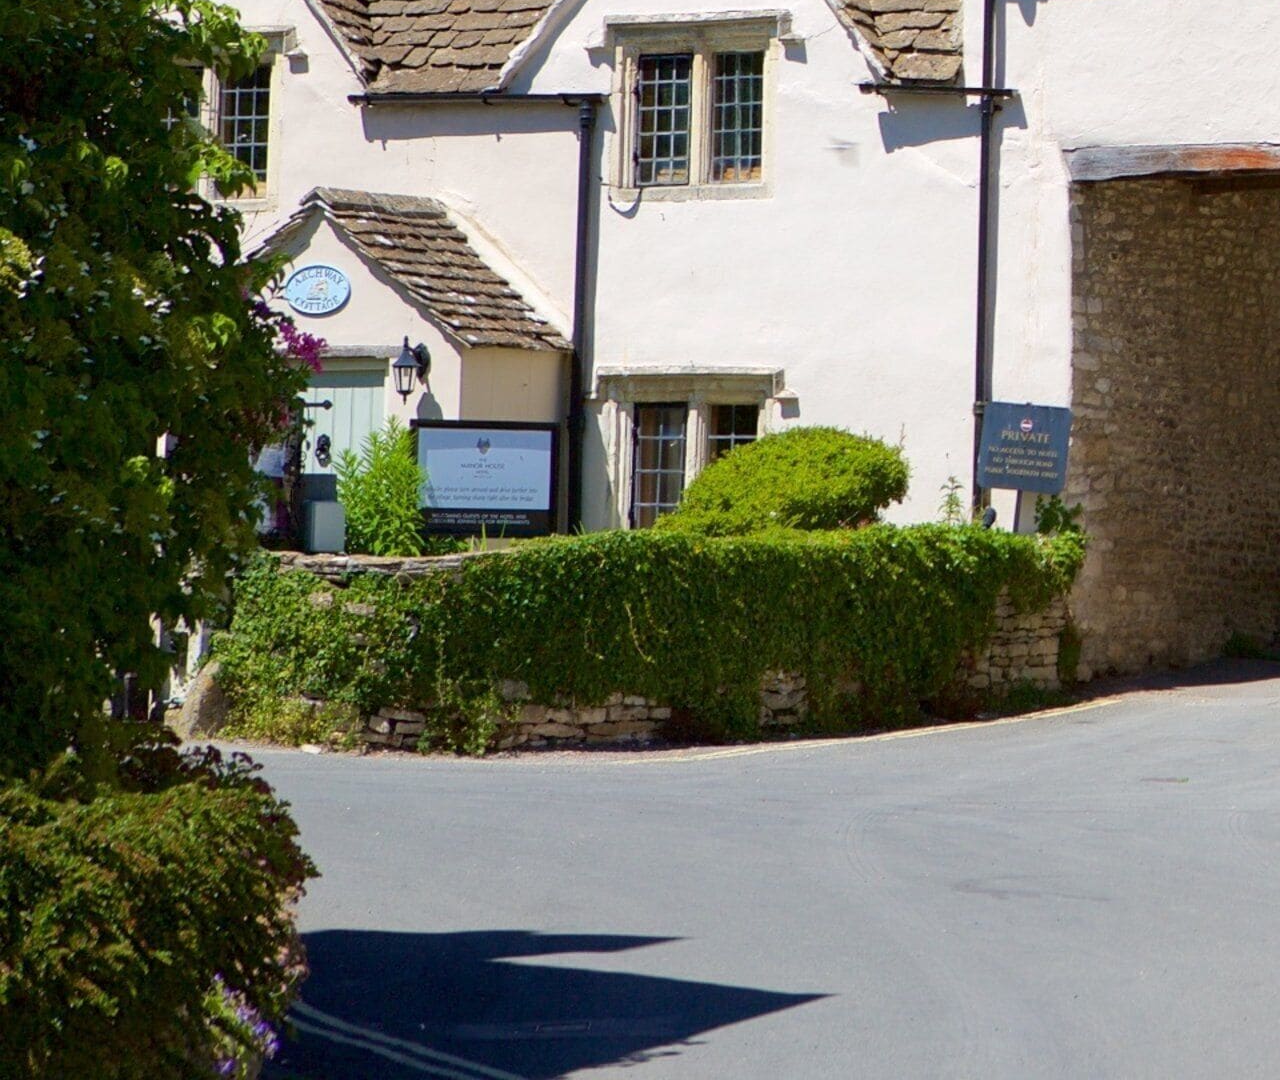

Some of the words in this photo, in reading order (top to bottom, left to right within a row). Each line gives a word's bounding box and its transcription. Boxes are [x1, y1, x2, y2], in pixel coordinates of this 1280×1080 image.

[294, 269, 344, 287] ARCHWAY
[294, 295, 341, 311] COTTAGE
[1001, 430, 1050, 444] PRIVATE
[1000, 446, 1025, 455] ACCESS
[1041, 471, 1059, 479] ONLY
